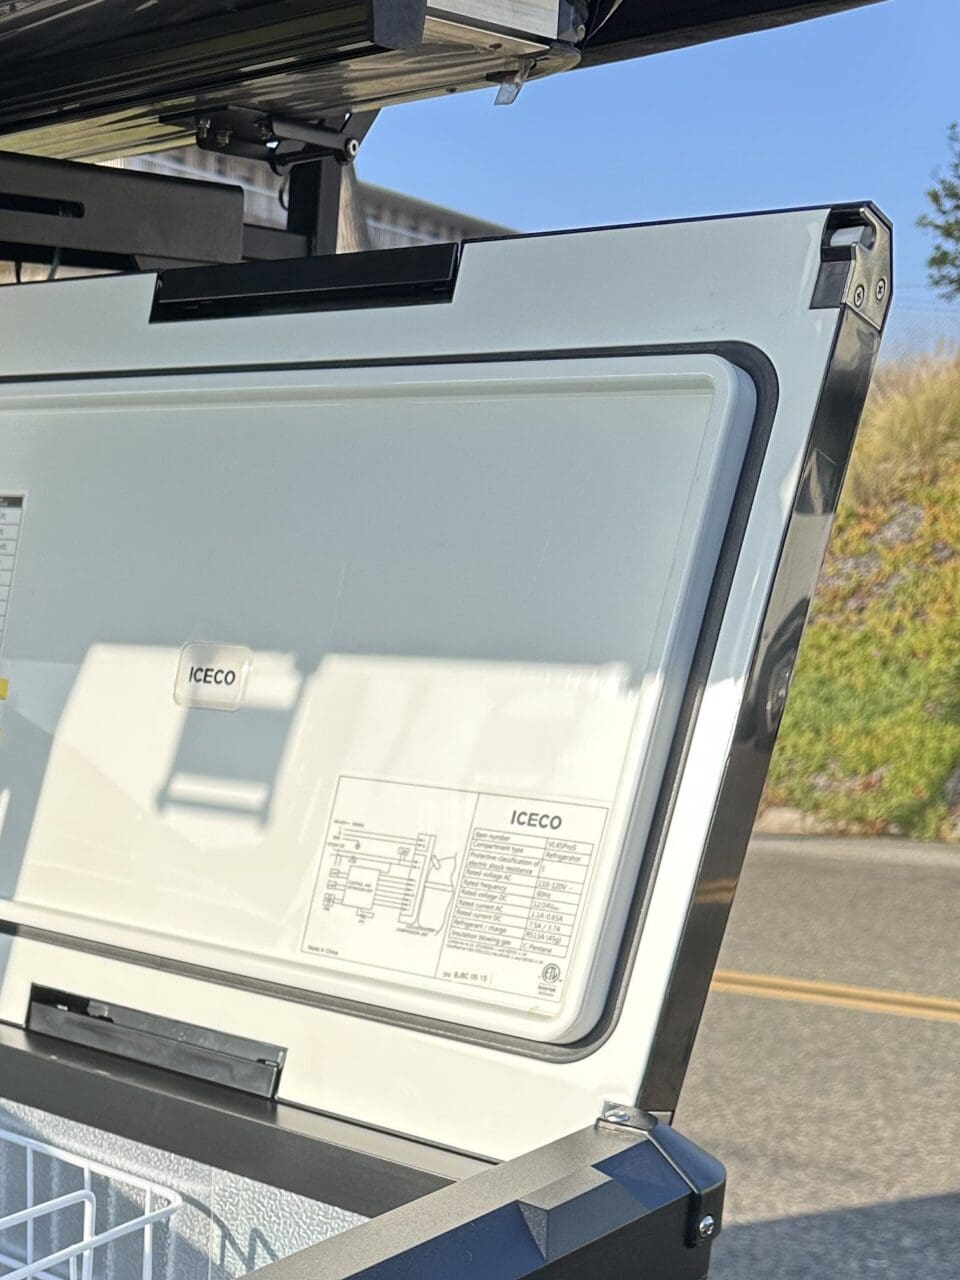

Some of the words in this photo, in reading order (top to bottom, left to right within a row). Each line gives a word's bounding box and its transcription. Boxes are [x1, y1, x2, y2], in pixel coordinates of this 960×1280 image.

[189, 666, 236, 686] ICECO
[510, 810, 562, 830] ICECO
[488, 833, 510, 841] number
[472, 840, 511, 852] Compartment
[497, 855, 533, 866] classification
[545, 851, 581, 863] Refrigerator
[505, 865, 532, 874] resistance
[482, 871, 502, 881] voltage
[463, 879, 479, 887] Rated
[479, 881, 507, 892] frequency
[477, 891, 497, 901] voltage
[475, 902, 494, 910] current
[473, 912, 492, 920] current
[451, 929, 477, 939] Insulation
[487, 924, 507, 934] charge
